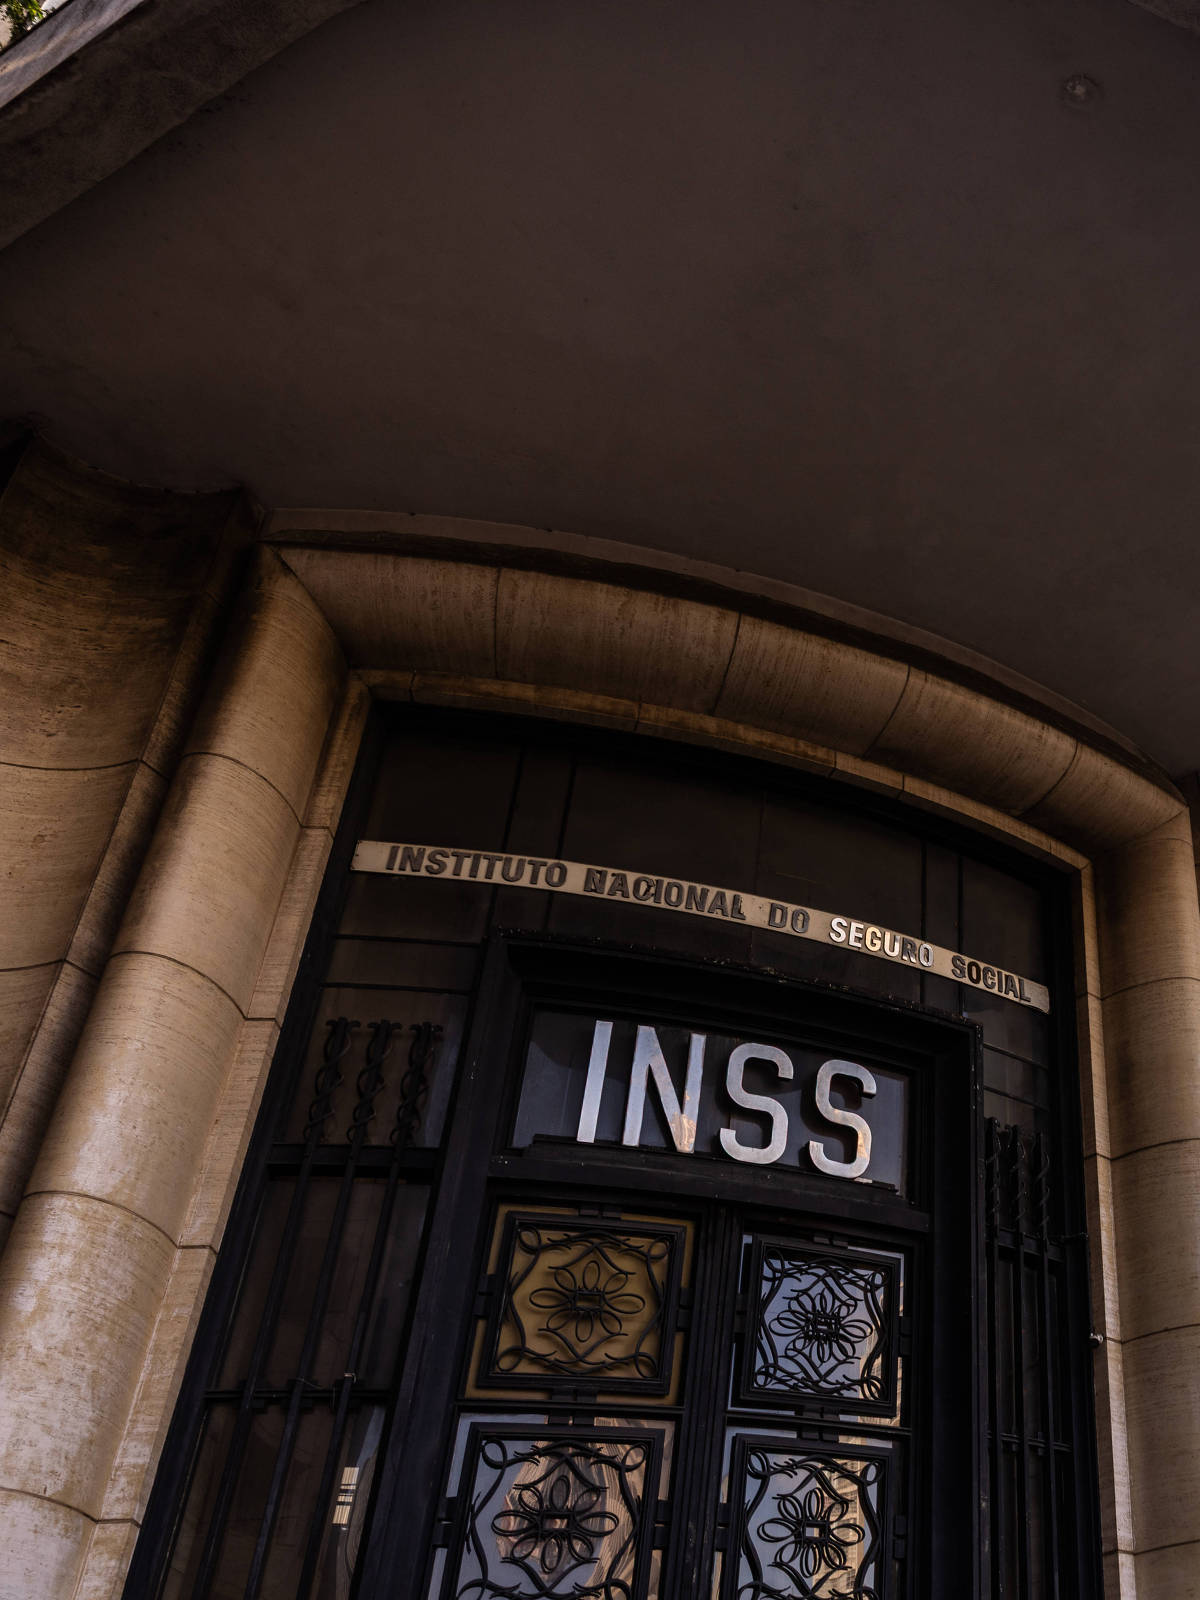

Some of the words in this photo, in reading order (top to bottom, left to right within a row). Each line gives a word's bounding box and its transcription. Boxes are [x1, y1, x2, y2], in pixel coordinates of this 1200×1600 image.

[386, 845, 567, 888] INSTITUTO
[583, 867, 746, 921] NACIONAL
[768, 902, 810, 933] DO
[829, 917, 935, 968] SEGURO
[951, 954, 1032, 1003] SOCIAL
[576, 1019, 877, 1179] INSS
